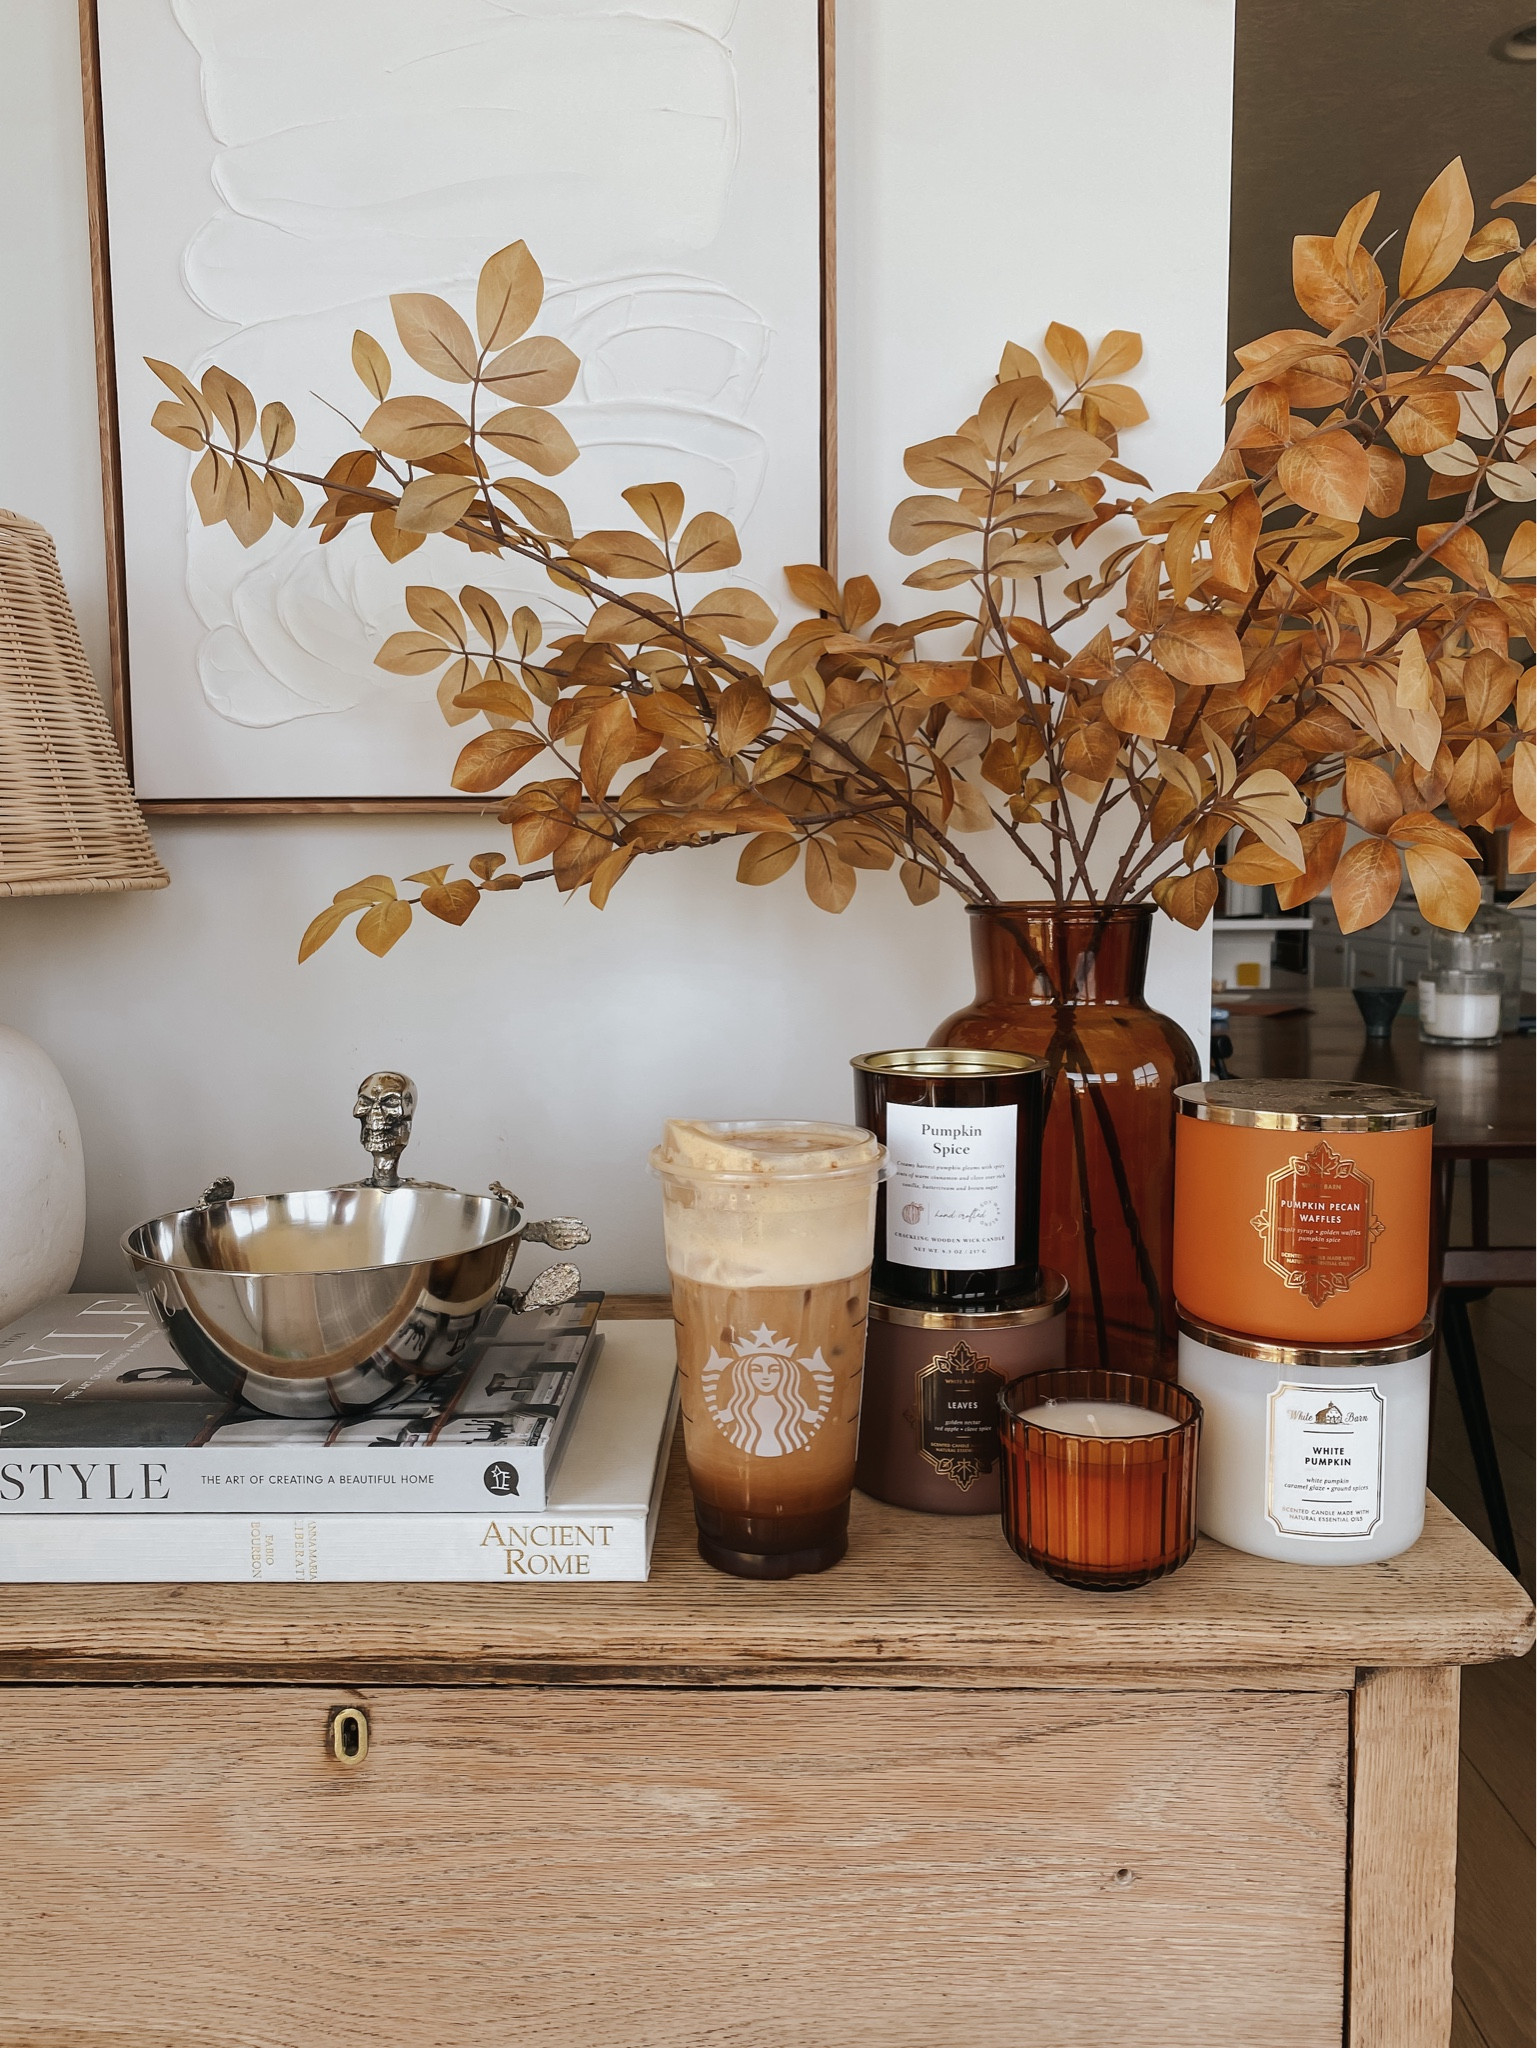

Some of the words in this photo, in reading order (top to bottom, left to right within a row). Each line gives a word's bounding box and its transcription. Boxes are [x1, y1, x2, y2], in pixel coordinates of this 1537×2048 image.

[921, 1123, 982, 1140] Pumpkin
[933, 1142, 970, 1157] Spice
[896, 1160, 915, 1168] Creamy
[1280, 1200, 1325, 1211] PUMPKIN
[1329, 1203, 1361, 1212] PECAN
[935, 1209, 956, 1219] hand
[958, 1207, 987, 1223] crafted
[1299, 1213, 1342, 1224] WAFFLES
[894, 1231, 929, 1241] CRACKLING
[982, 1235, 1005, 1243] CANDLE
[1277, 1226, 1296, 1234] maple
[1341, 1229, 1361, 1237] waffles
[1298, 1235, 1325, 1243] pumpkin
[947, 1401, 979, 1410] LEAVES
[1287, 1410, 1314, 1422] White
[1344, 1411, 1369, 1423] Barn
[1312, 1446, 1345, 1456] WHITE
[1305, 1457, 1352, 1467] PUMPKIN
[0, 1463, 170, 1500] STYLE
[201, 1475, 221, 1484] THE
[225, 1475, 245, 1484] ART
[249, 1475, 264, 1484] OF
[268, 1475, 324, 1484] CREATING
[327, 1475, 336, 1484] A
[339, 1475, 396, 1484] BEAUTIFUL
[401, 1474, 434, 1484] HOME
[1284, 1482, 1308, 1490] caramel
[1308, 1484, 1325, 1492] glaze
[1281, 1505, 1309, 1514] SCENTED
[1289, 1514, 1316, 1522] NATURAL
[480, 1521, 614, 1547] ANCIENT
[250, 1521, 262, 1578] BOURBON
[265, 1534, 275, 1566] FABIO
[308, 1521, 318, 1581] ANNAMARIA
[503, 1548, 590, 1575] ROME
